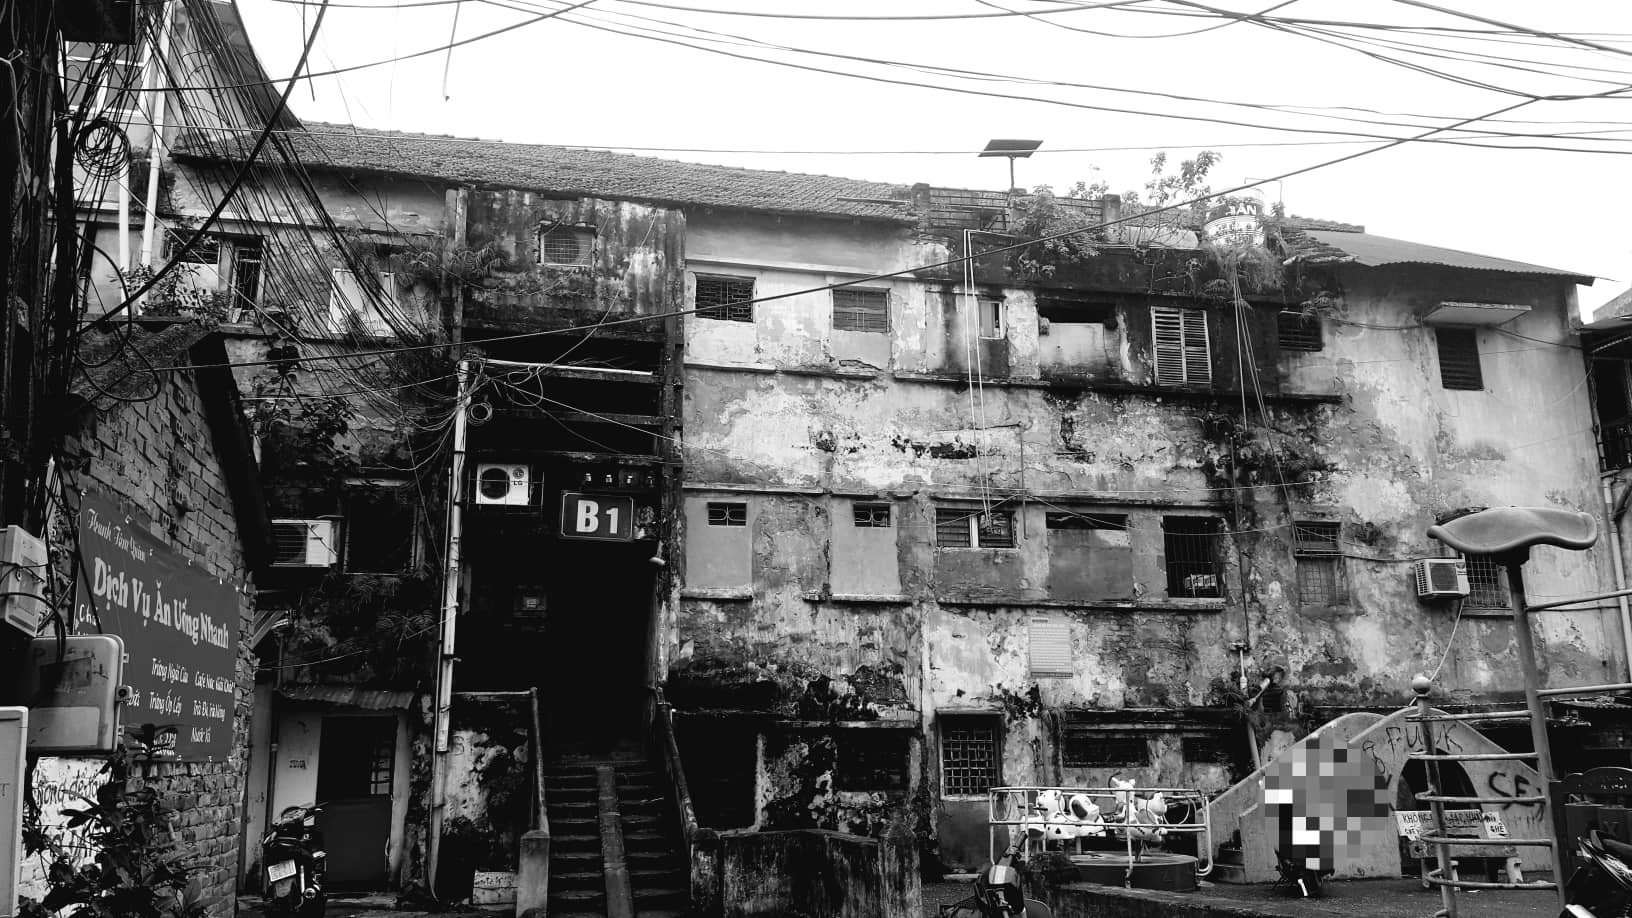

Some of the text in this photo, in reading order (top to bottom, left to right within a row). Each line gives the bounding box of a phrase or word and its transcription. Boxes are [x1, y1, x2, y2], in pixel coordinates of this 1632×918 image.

[94, 557, 229, 649] Dịch Vụ Ăn Uống Nhanh
